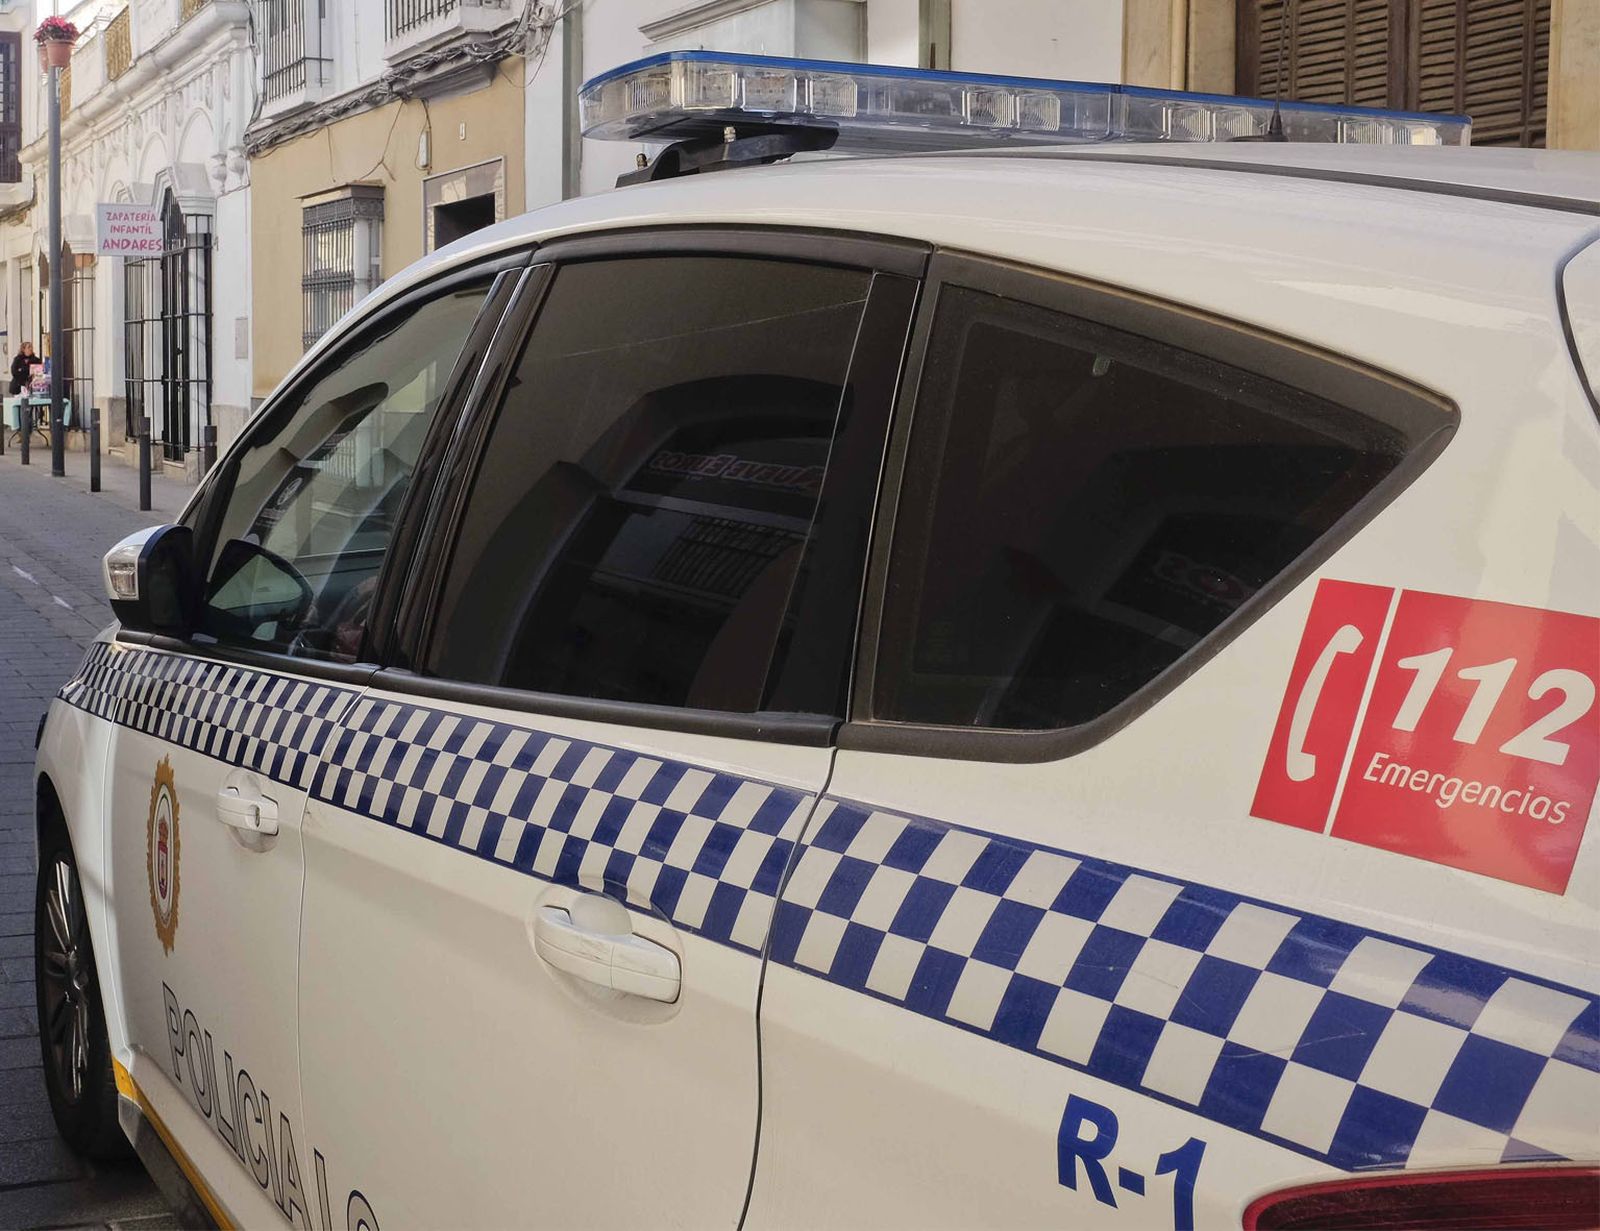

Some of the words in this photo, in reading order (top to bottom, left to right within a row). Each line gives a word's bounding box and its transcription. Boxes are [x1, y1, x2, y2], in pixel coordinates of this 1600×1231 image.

[102, 238, 162, 251] ANDARES
[105, 210, 156, 221] ZAPATERÍA
[1391, 646, 1597, 766] 112
[1362, 751, 1571, 825] Emergencias
[161, 979, 315, 1231] POLICIA
[1057, 1092, 1208, 1231] R-1
